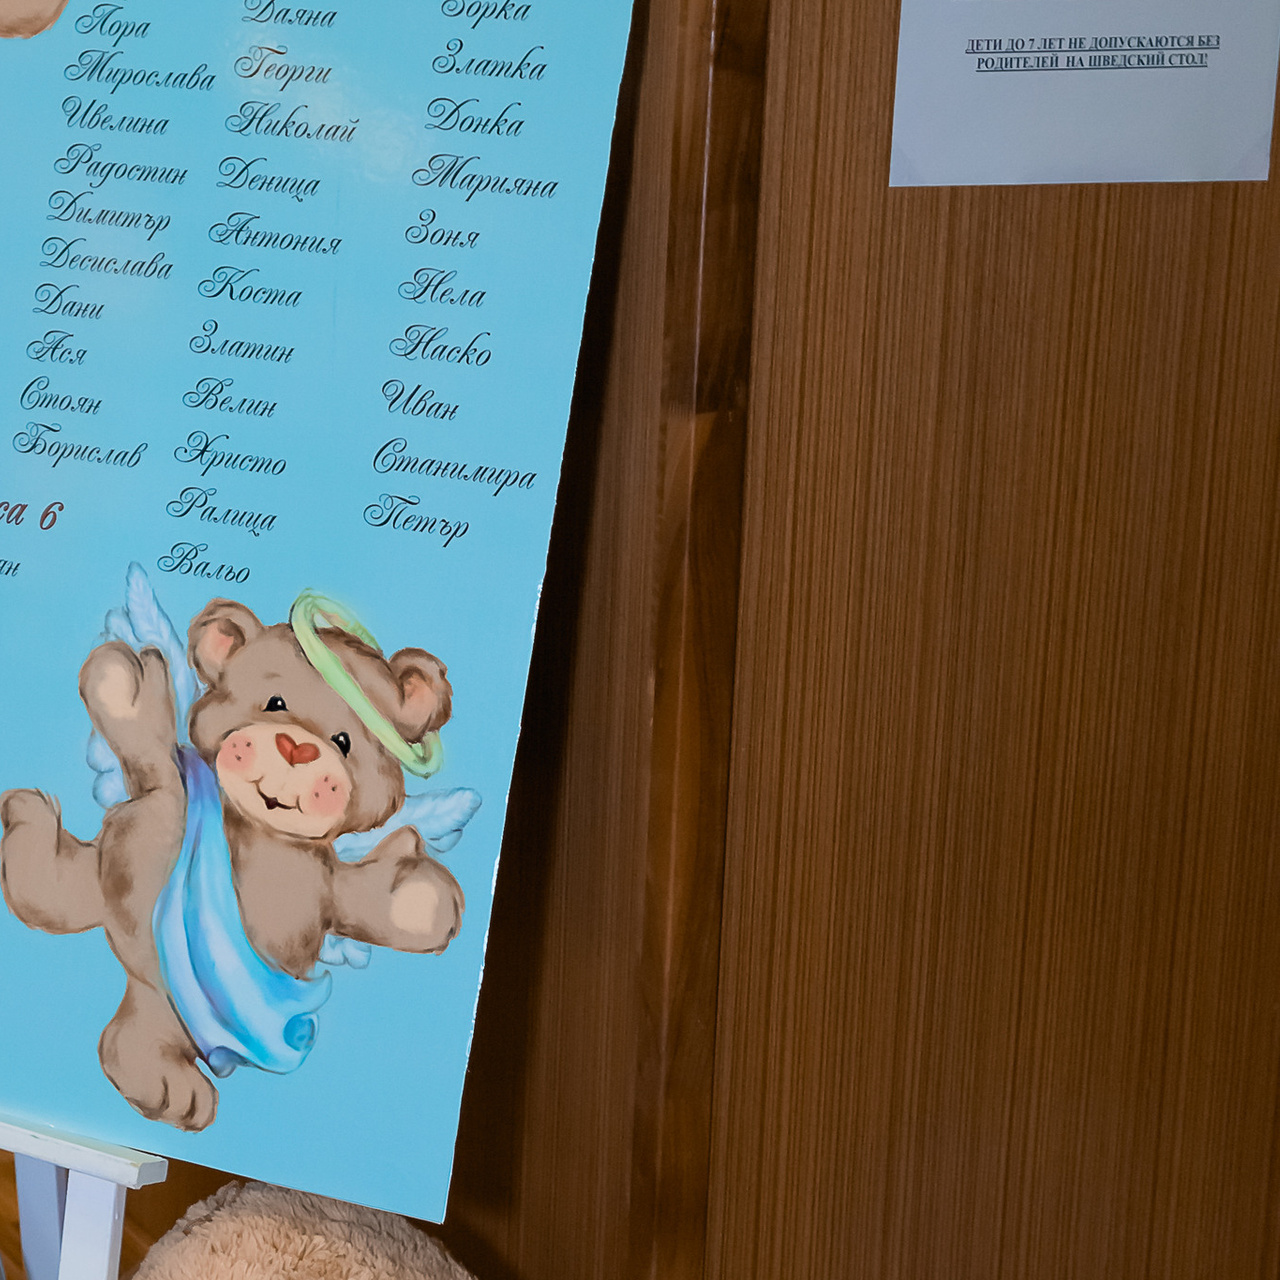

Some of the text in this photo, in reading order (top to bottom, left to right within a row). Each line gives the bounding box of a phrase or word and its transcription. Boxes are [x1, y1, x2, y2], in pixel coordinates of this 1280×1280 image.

[966, 35, 1220, 53] ДЕТИ ЛЕТ ДОПУСКАЮТСЯ БЕЗ
[977, 52, 1207, 70] РОДИТЕЛЕЙ ШВЕДСКИЙ СТОЛ!
[39, 501, 65, 531] 6
